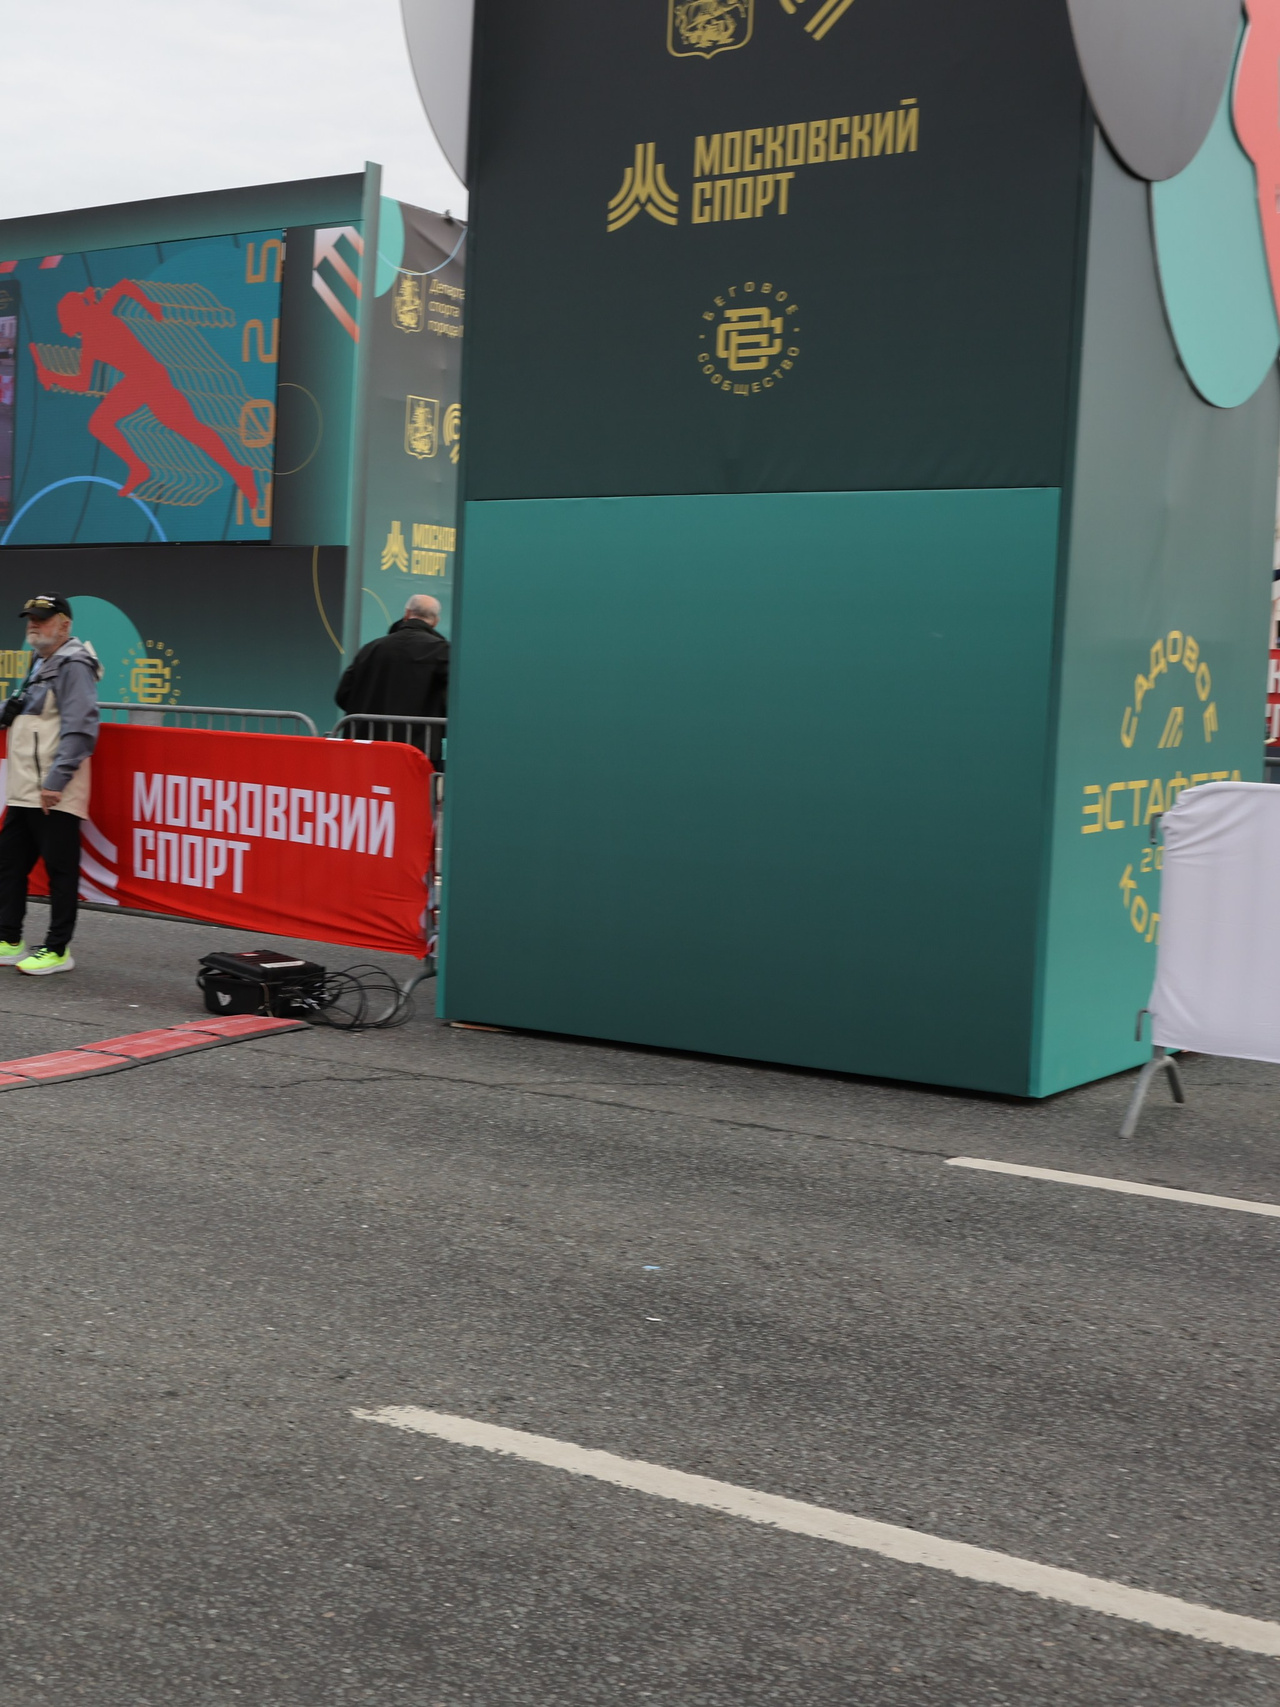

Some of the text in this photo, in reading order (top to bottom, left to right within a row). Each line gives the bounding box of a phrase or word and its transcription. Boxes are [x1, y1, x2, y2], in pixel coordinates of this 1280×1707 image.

[693, 97, 920, 178] МОСКОВСКИЙ
[691, 171, 796, 224] СПОРТ
[429, 279, 465, 300] Департа
[702, 281, 799, 321] БЕГОВОЕ
[698, 346, 800, 396] СООБЩЕСТВО
[412, 523, 456, 552] МОСКОВ
[1121, 630, 1219, 749] САДОВОЕ
[133, 771, 395, 858] МОСКОВСКИЙ
[1081, 771, 1242, 834] ЭСТА
[133, 827, 251, 894] СПОРТ
[1140, 846, 1163, 873] 20
[1119, 864, 1162, 946] КОЛ
